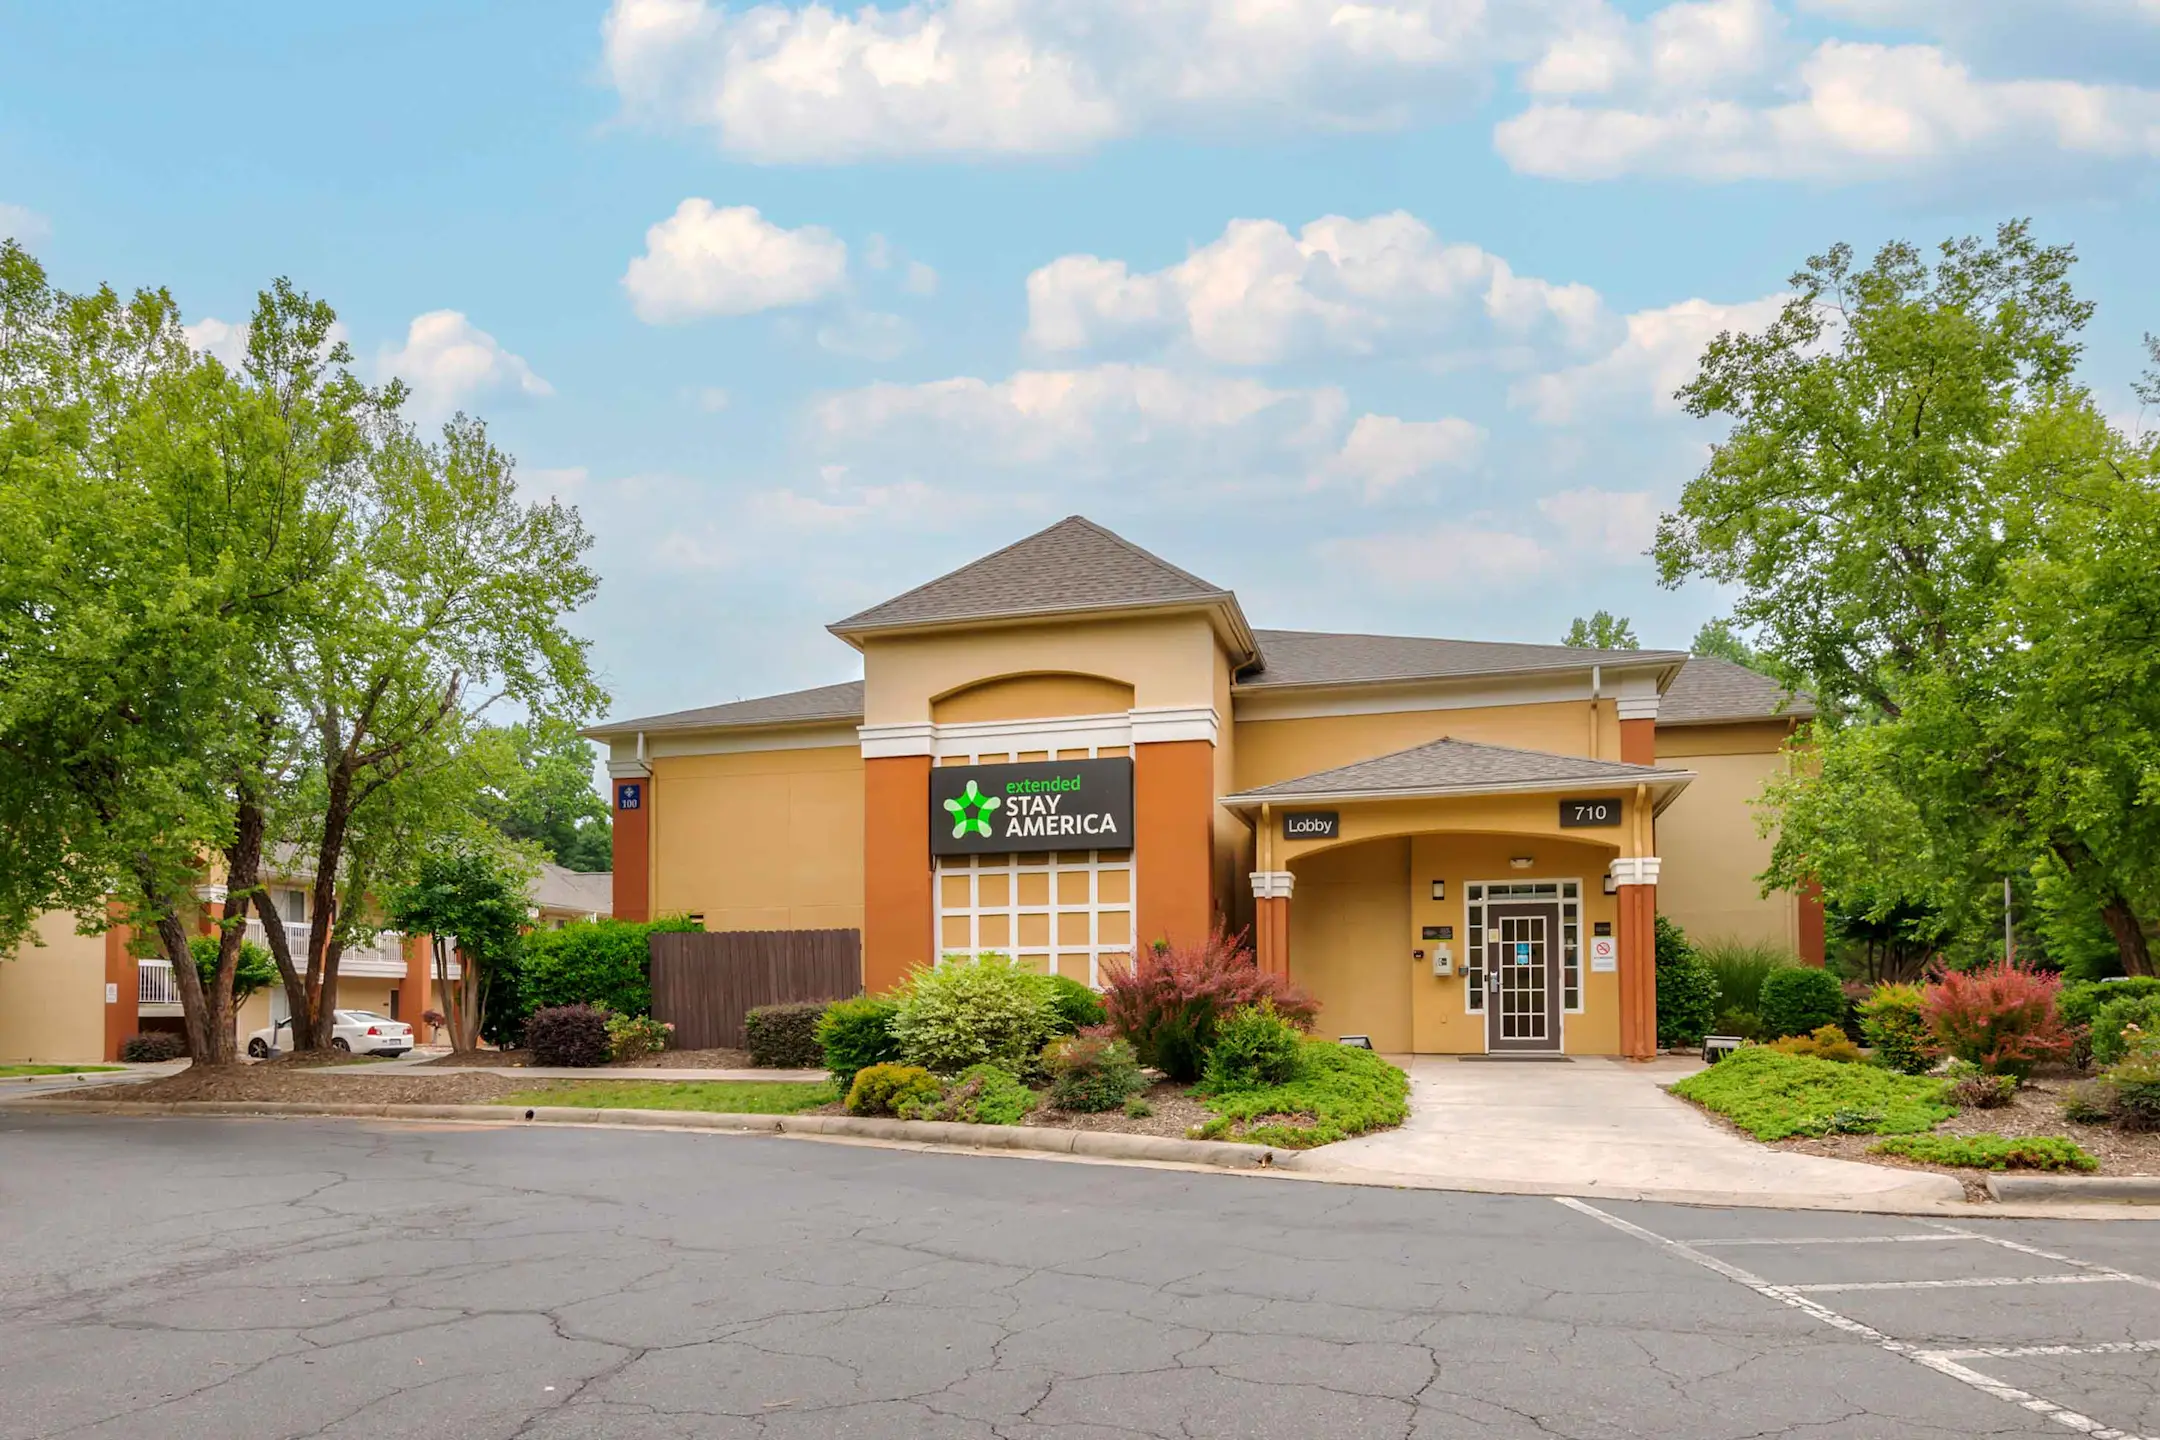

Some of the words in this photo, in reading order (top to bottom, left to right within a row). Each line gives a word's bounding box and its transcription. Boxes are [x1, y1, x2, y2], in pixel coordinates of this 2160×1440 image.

[1006, 774, 1081, 794] extended
[622, 799, 637, 808] 100
[1006, 794, 1061, 816] STAY
[1575, 805, 1607, 820] 710
[1005, 813, 1118, 837] AMERICA
[1289, 818, 1332, 834] Lobby
